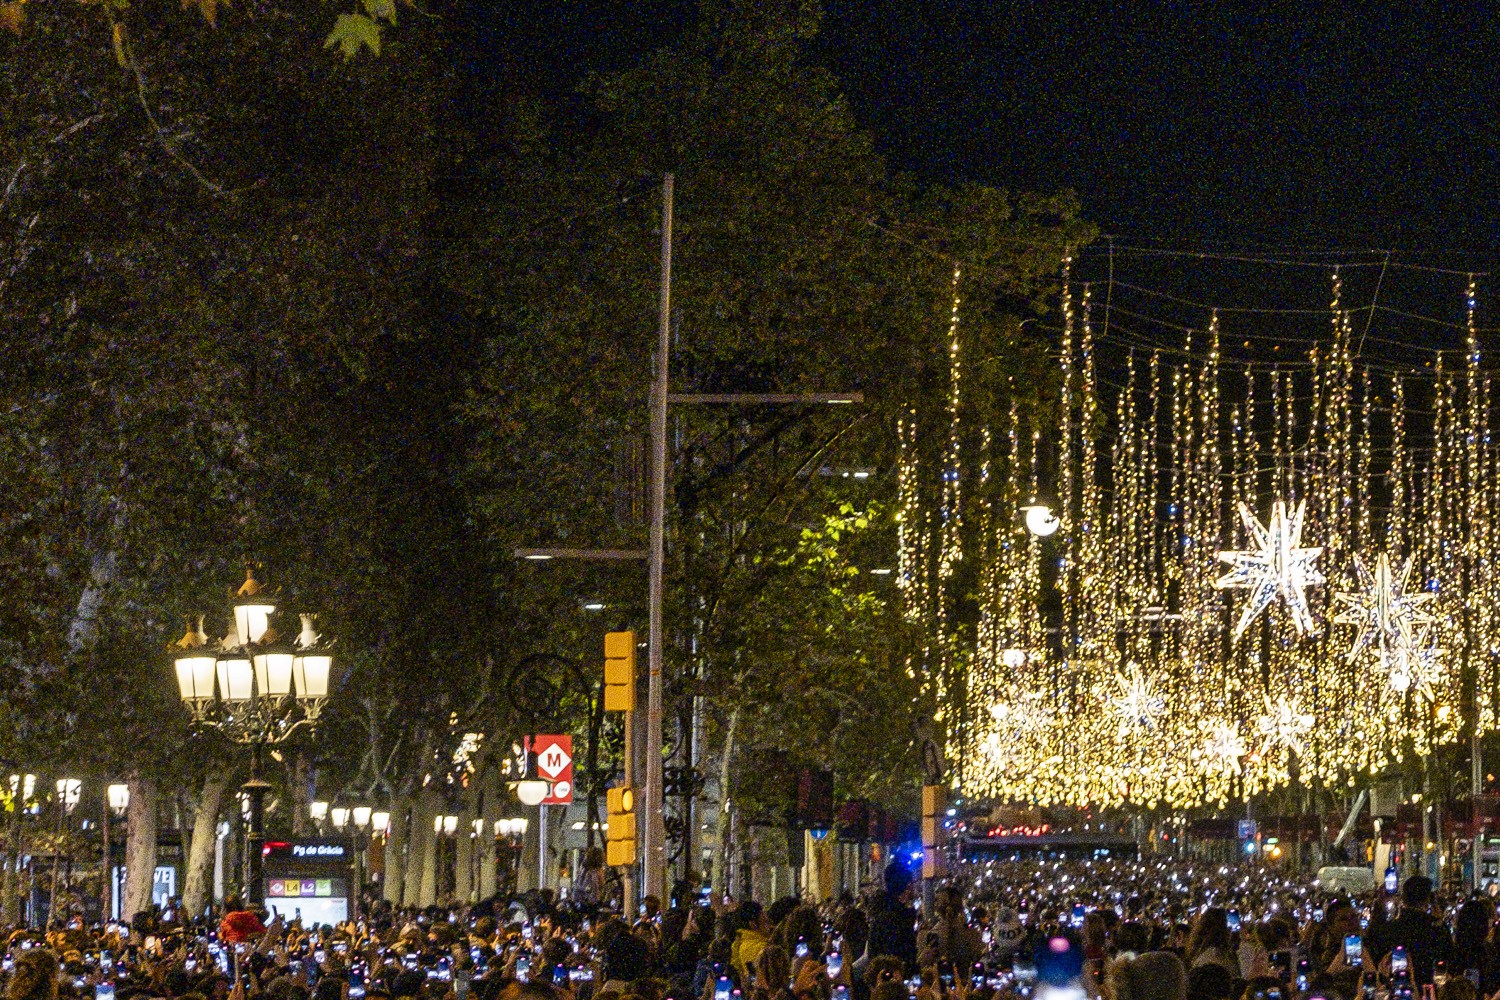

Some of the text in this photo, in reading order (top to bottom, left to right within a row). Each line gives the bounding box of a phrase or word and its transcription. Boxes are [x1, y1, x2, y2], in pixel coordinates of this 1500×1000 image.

[547, 753, 561, 767] M
[293, 845, 305, 856] Pg
[306, 845, 317, 855] de
[286, 884, 298, 893] L4
[301, 883, 314, 893] L2
